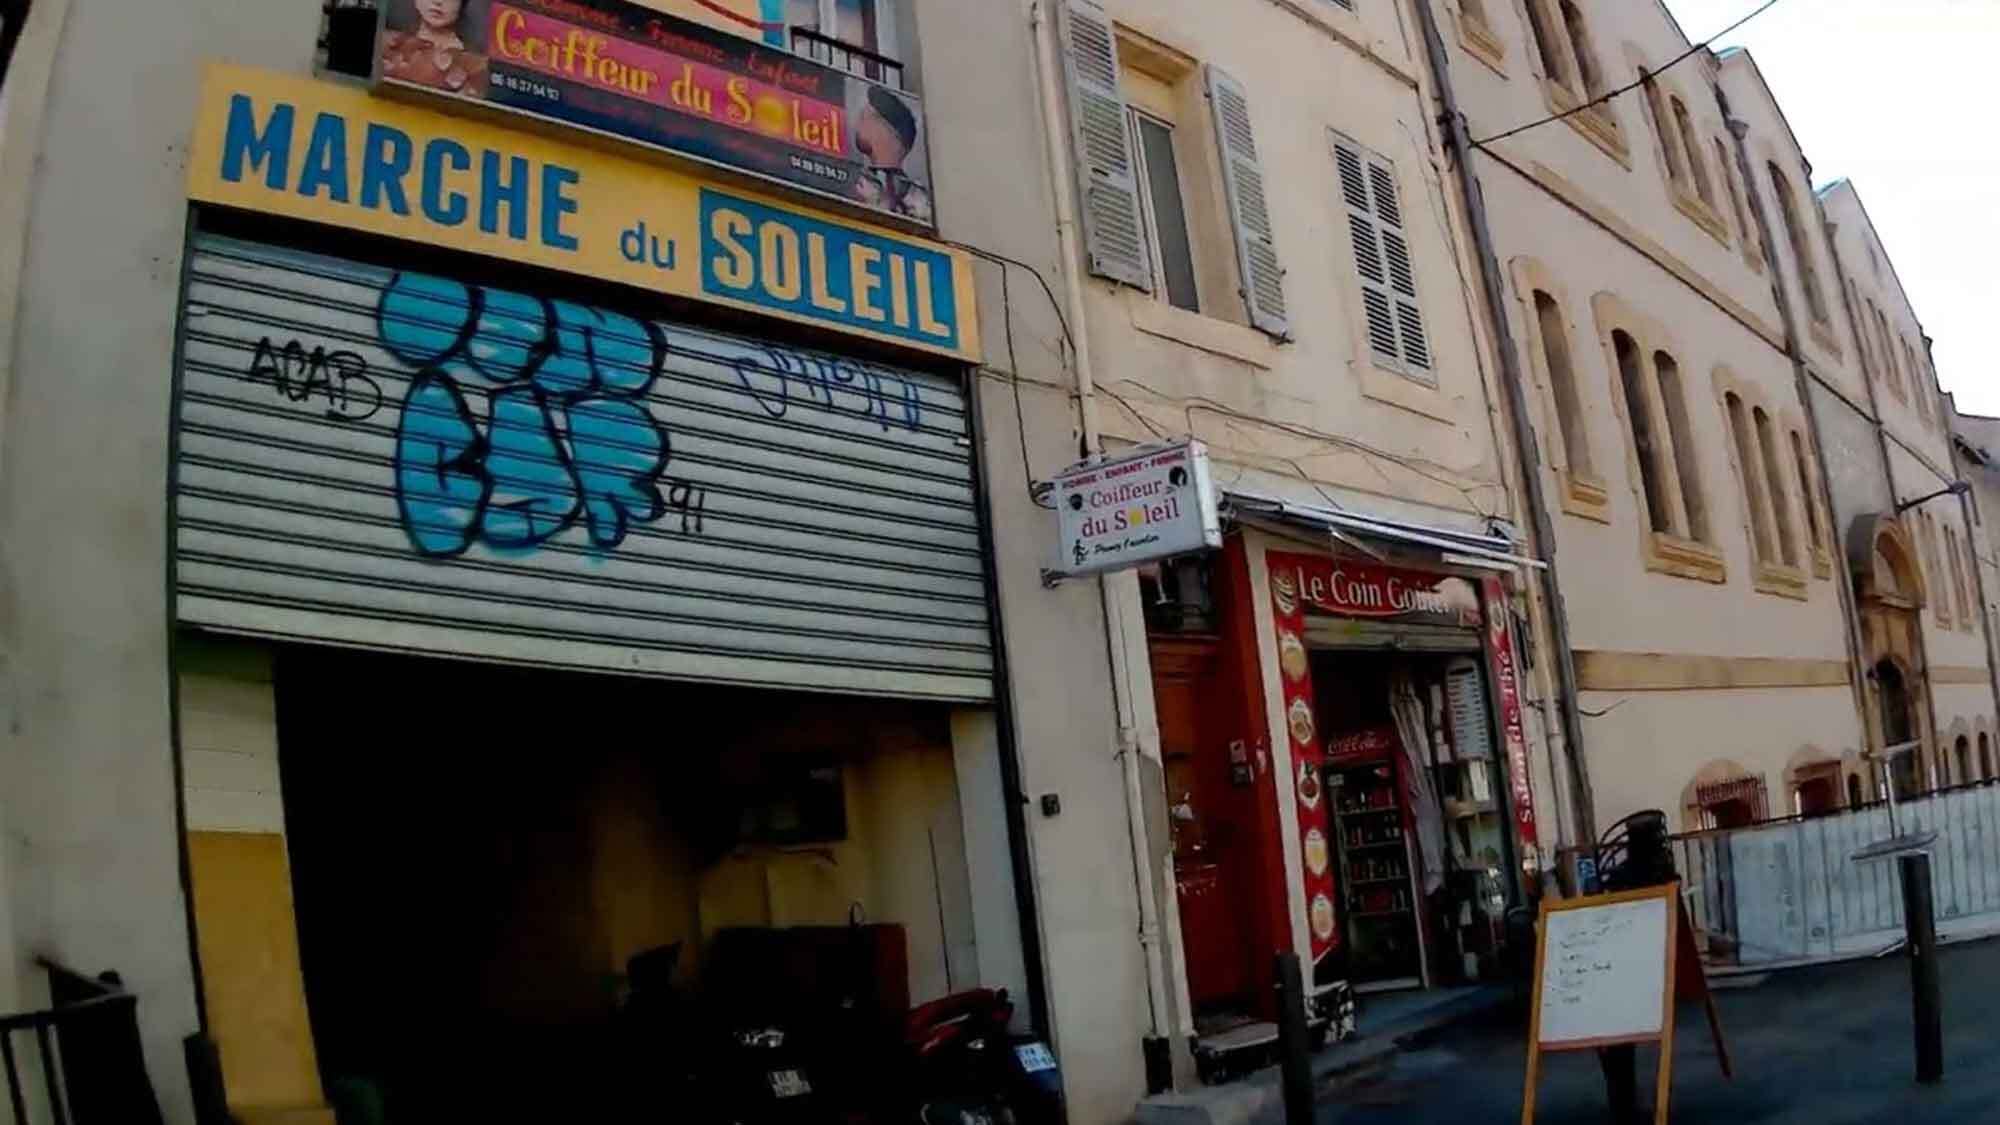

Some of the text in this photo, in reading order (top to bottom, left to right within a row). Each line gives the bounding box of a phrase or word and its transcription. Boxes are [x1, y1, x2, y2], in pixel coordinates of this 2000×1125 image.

[495, 9, 658, 95] Coiffeur
[671, 63, 713, 115] du
[220, 93, 580, 252] MARCHE
[619, 221, 676, 270] du
[710, 207, 950, 338] SOLEIL
[249, 335, 383, 421] ACAB
[1090, 479, 1163, 509] Coiffeur
[1104, 461, 1144, 480] ENFANT
[1081, 517, 1108, 538] du
[1296, 566, 1324, 602] Le
[1330, 569, 1382, 608] Coin
[1510, 752, 1535, 824] Salon
